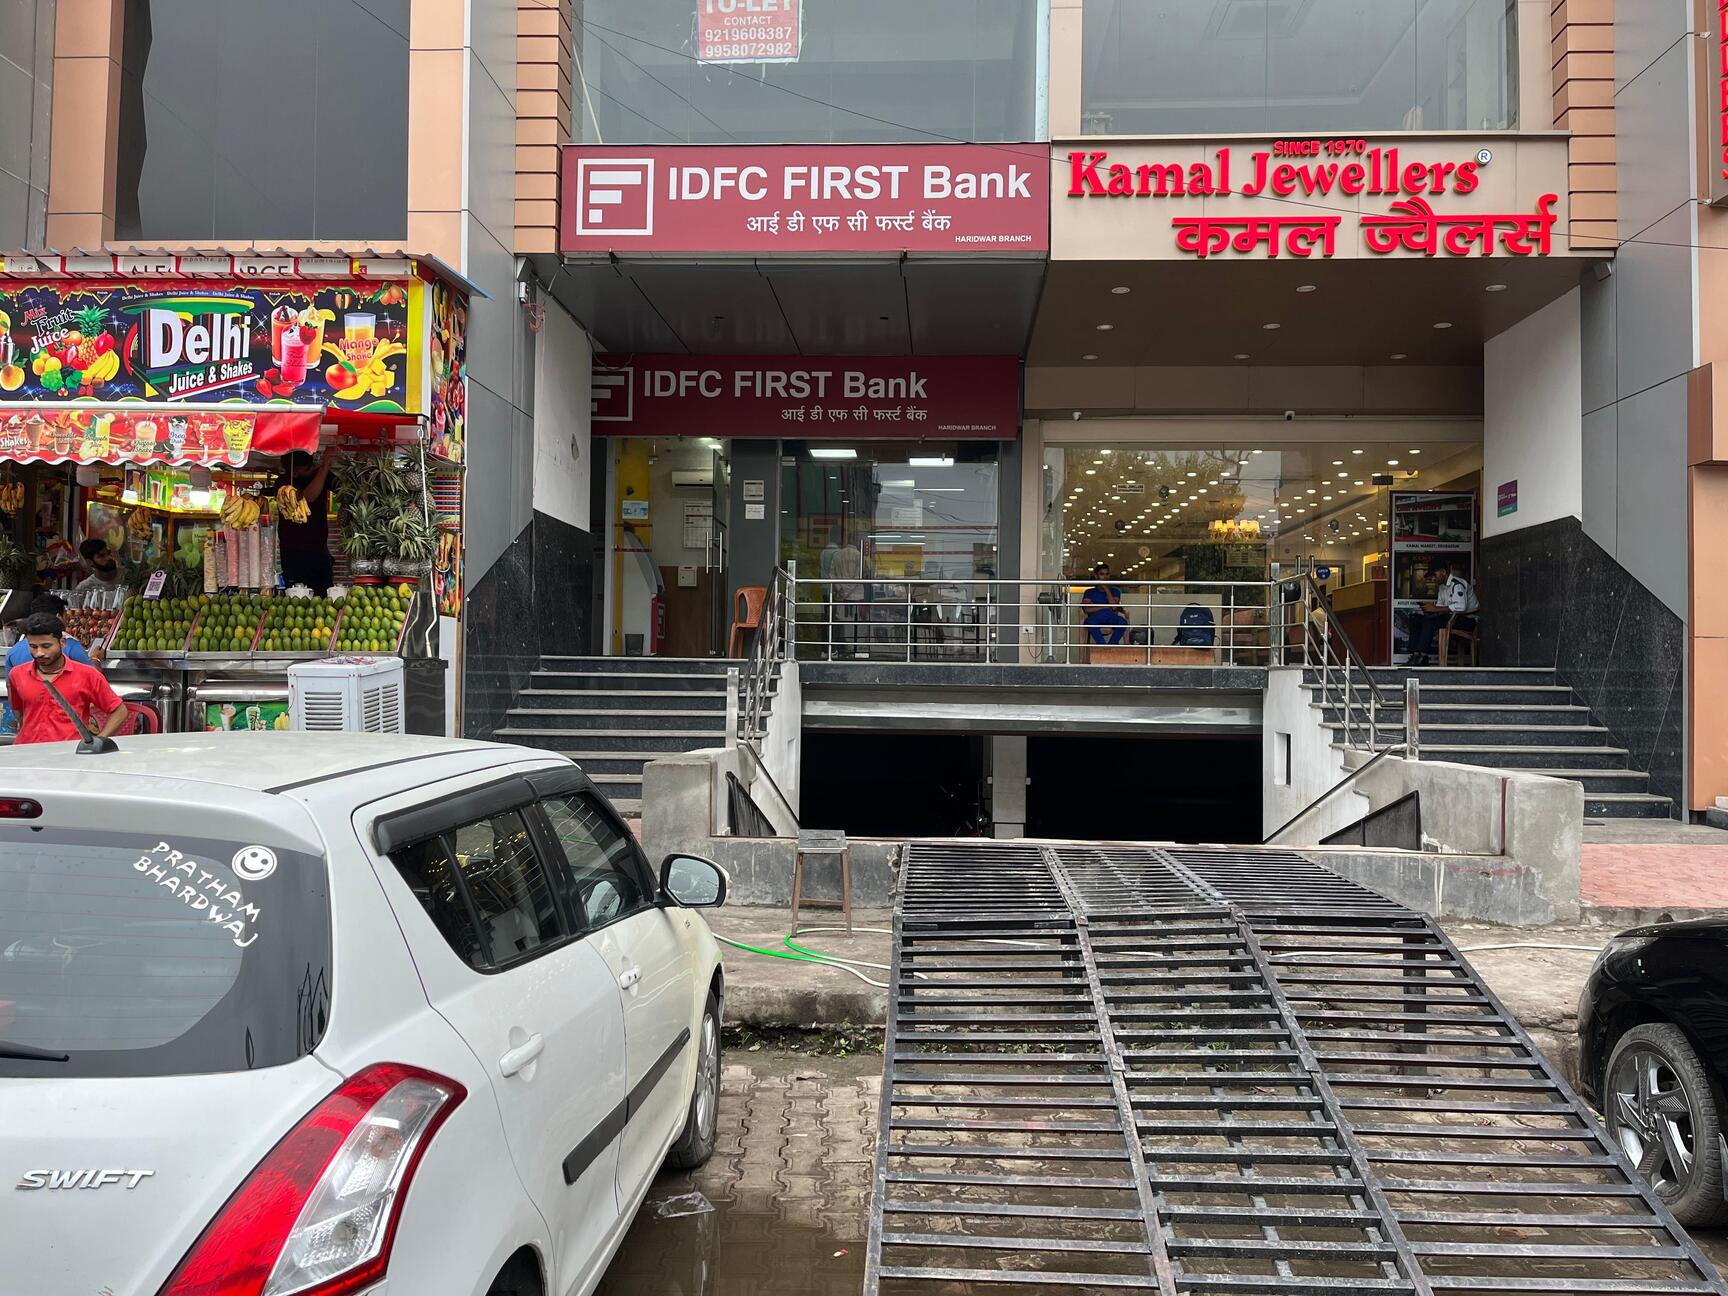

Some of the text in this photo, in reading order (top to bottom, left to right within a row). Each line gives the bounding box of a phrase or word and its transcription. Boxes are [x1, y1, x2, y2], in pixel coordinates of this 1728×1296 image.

[724, 16, 773, 26] CONTACT
[705, 27, 792, 42] 9219608387
[705, 43, 792, 57] 9958072982
[1273, 139, 1368, 156] SINCE 1970
[669, 164, 1032, 201] IDFC FIRST Bank
[1067, 147, 1231, 197] Kamal
[1241, 147, 1480, 197] Jewellers
[746, 209, 952, 234] आई डी एफ सी फर्स्ट बैंक
[1171, 193, 1559, 257] कमल ज्वैलर्स
[955, 235, 1032, 243] HARIDWAR BRANCH
[20, 306, 47, 327] Mix
[30, 308, 75, 338] Fruit
[30, 327, 70, 354] Juice
[150, 309, 250, 368] Delhi
[338, 337, 379, 351] Mango
[169, 361, 253, 393] Juice & Shakes
[644, 370, 929, 399] IDFC FIRST Bank
[781, 405, 928, 422] आई डी एफ सी फर्स्ट बैंक
[151, 841, 261, 923] PRATHAM
[132, 856, 259, 947] BHARDWAJ
[15, 1168, 155, 1190] SWIFT
